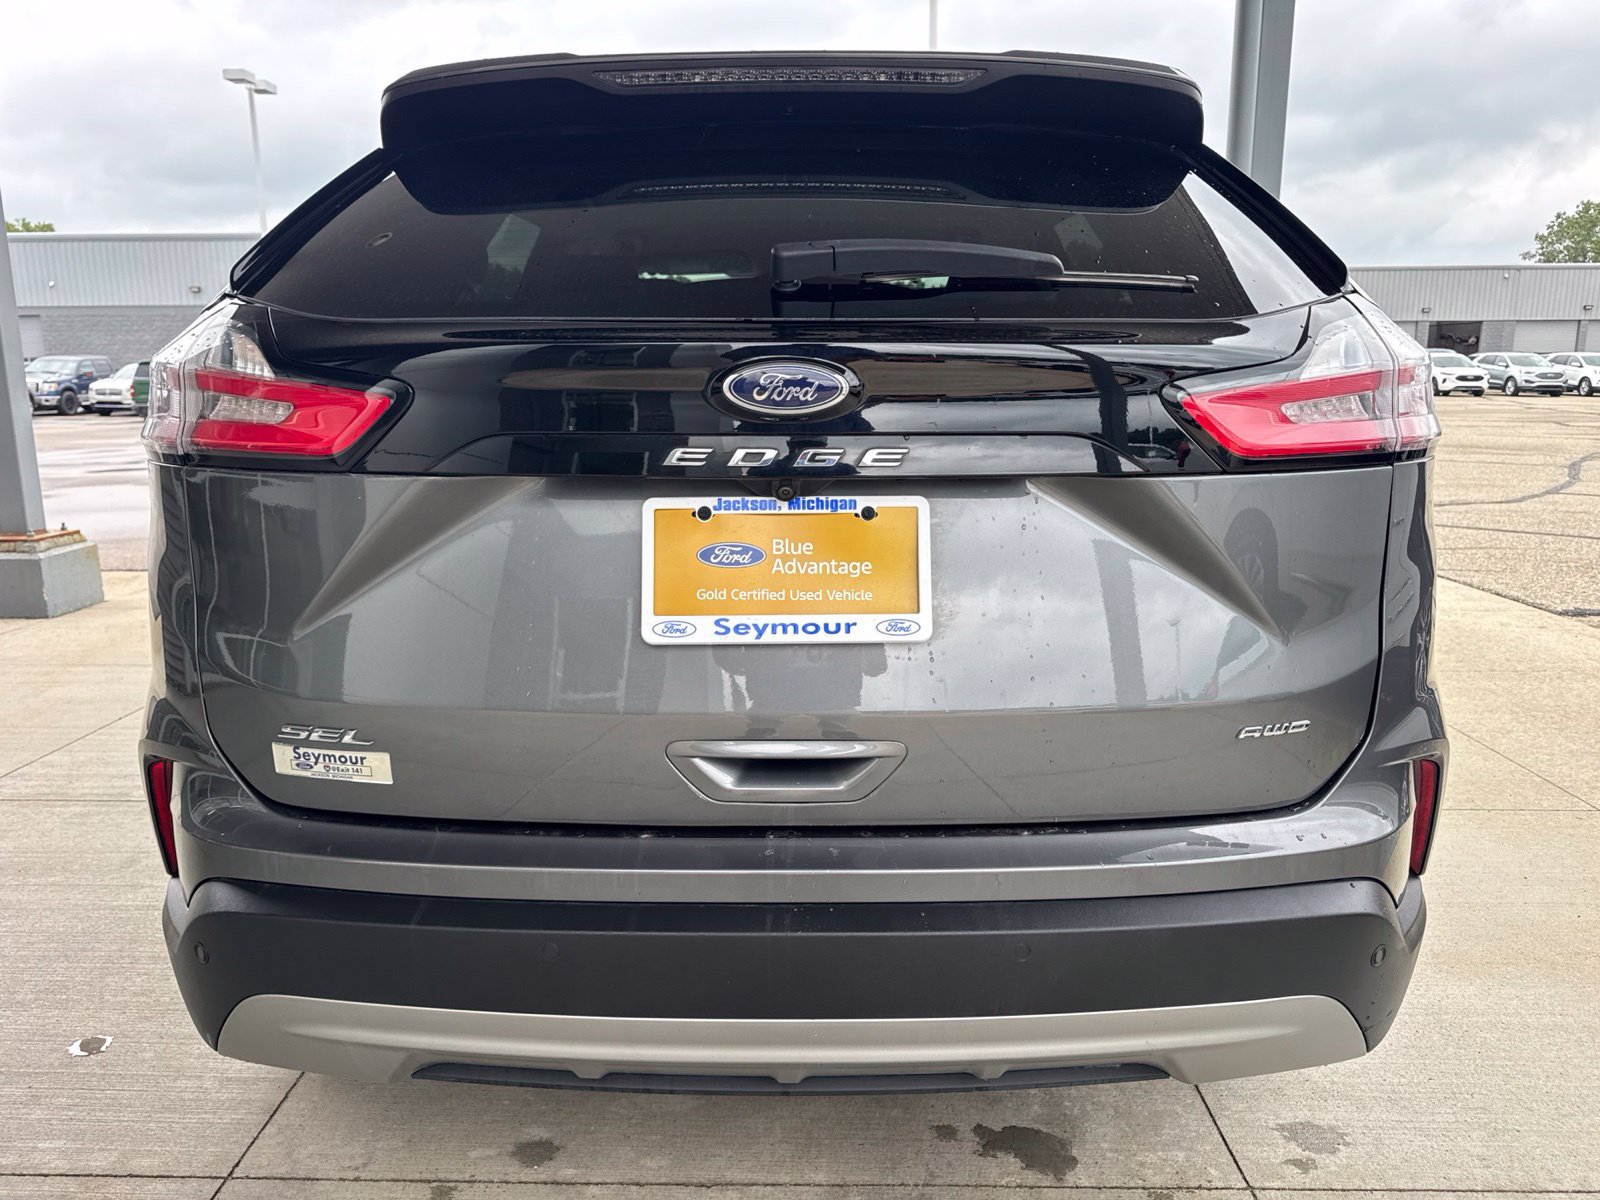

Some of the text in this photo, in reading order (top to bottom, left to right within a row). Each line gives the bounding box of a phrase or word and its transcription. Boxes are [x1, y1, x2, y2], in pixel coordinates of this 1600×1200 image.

[753, 372, 819, 401] Ford
[663, 447, 909, 467] EDGE
[713, 497, 857, 512] Jackson, Michigan
[711, 545, 752, 565] Ford
[772, 538, 814, 555] Blue
[771, 558, 873, 577] Advantage
[696, 587, 873, 601] Gold Certified Used Vehicle
[661, 623, 688, 635] Ford
[713, 617, 857, 640] Seymour
[885, 621, 912, 633] Ford
[277, 723, 375, 746] SEL
[1236, 719, 1311, 739] AWD
[292, 746, 367, 766] Seymour
